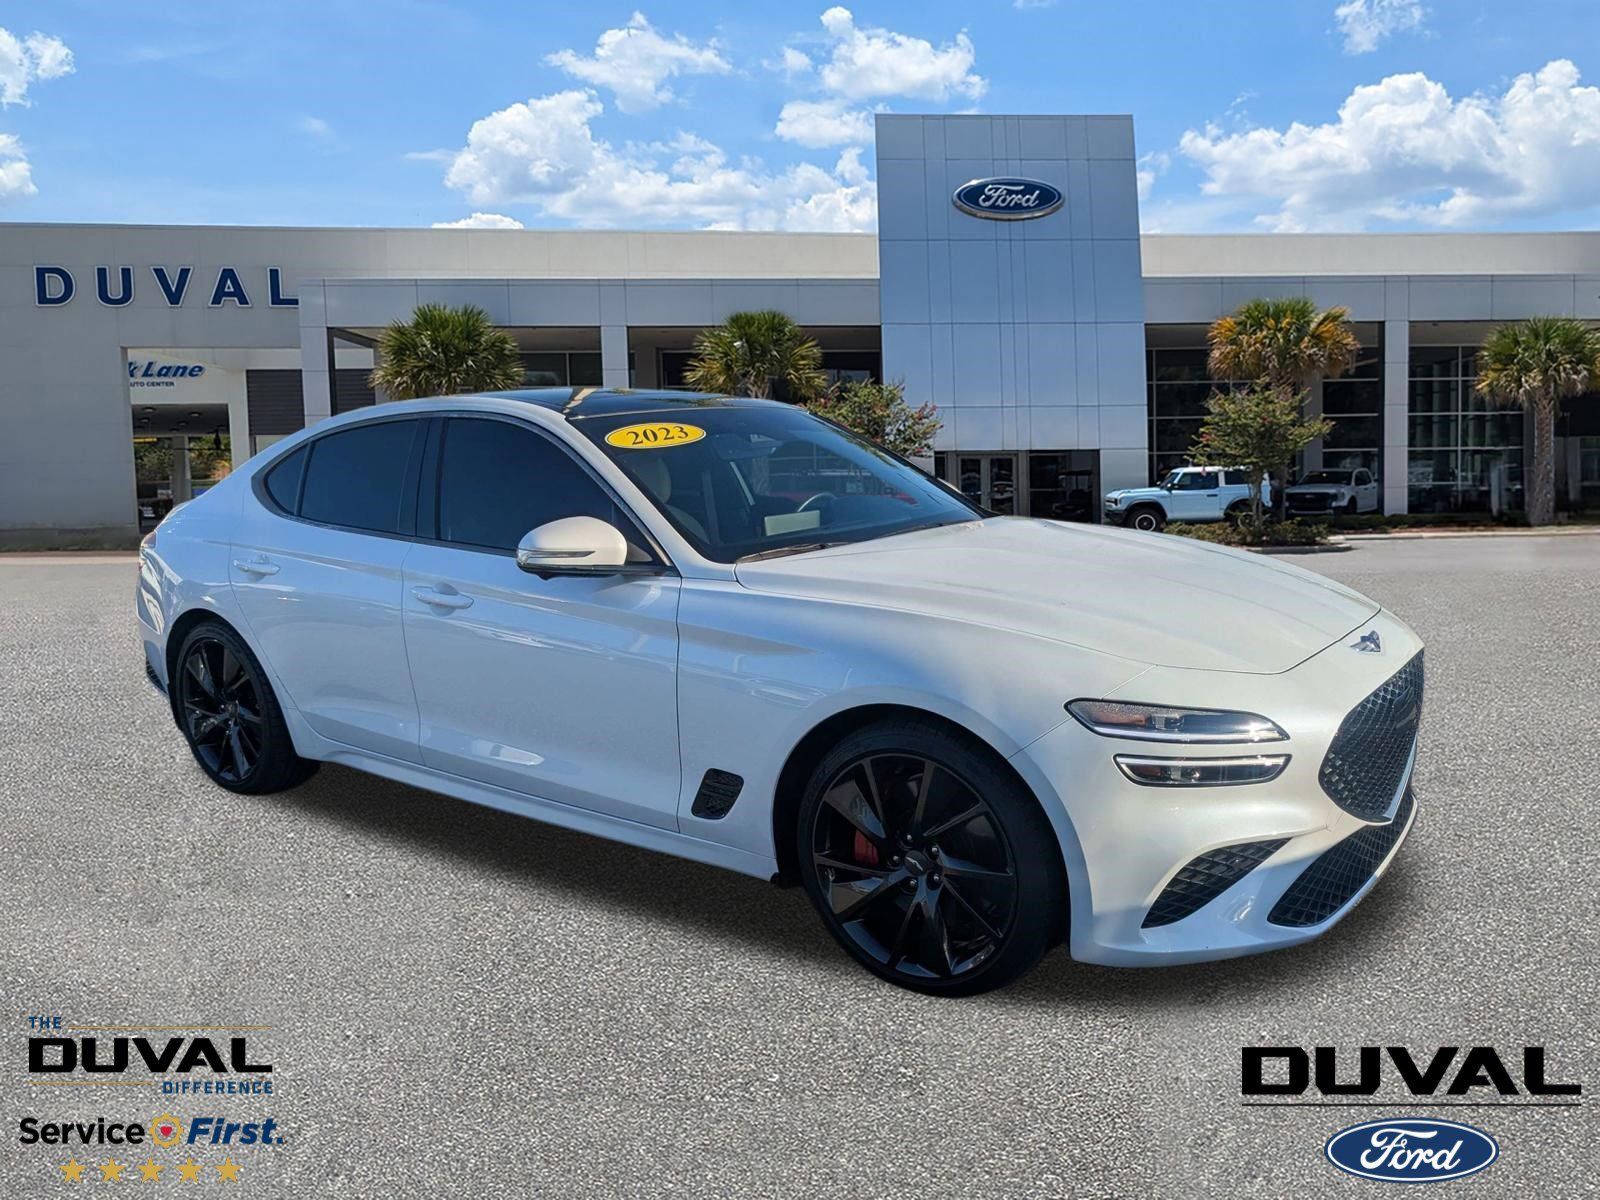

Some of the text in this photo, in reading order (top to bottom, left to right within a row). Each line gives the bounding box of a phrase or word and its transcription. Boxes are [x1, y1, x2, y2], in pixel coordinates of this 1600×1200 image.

[978, 184, 1041, 207] Ford
[33, 265, 299, 307] DUVAL
[142, 361, 205, 378] Lane
[626, 425, 689, 445] 2023
